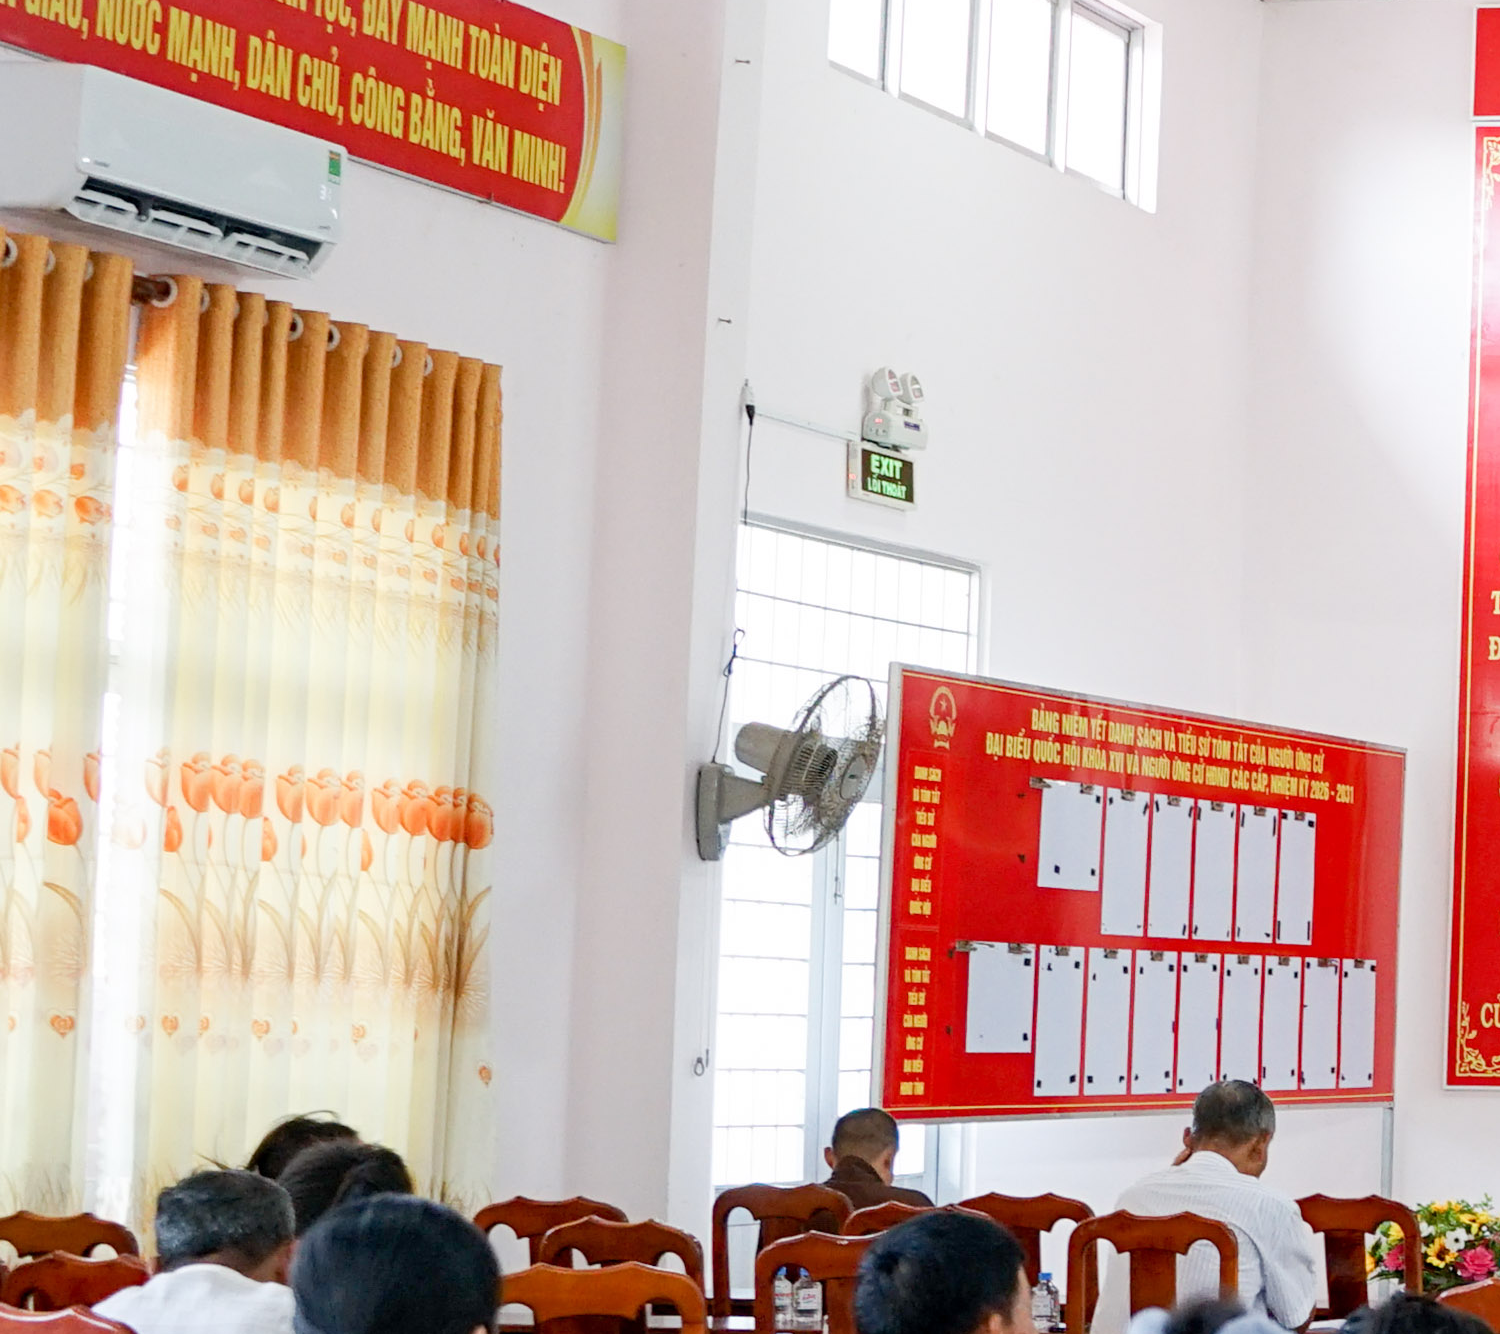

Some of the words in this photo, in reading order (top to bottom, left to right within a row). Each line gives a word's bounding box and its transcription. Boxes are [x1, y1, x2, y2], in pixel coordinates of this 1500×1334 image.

[167, 7, 240, 90] MẠNH,
[247, 30, 293, 100] DÂN
[297, 46, 343, 125] CHỦ,
[350, 67, 405, 139] CÔNG
[409, 78, 465, 166] BẰNG,
[472, 109, 509, 174] VĂN
[512, 130, 566, 193] MINH!
[406, 1, 464, 70] MẠNH
[469, 23, 516, 88] TOÀN
[519, 42, 562, 111] DIỆN
[870, 453, 903, 479] EXIT
